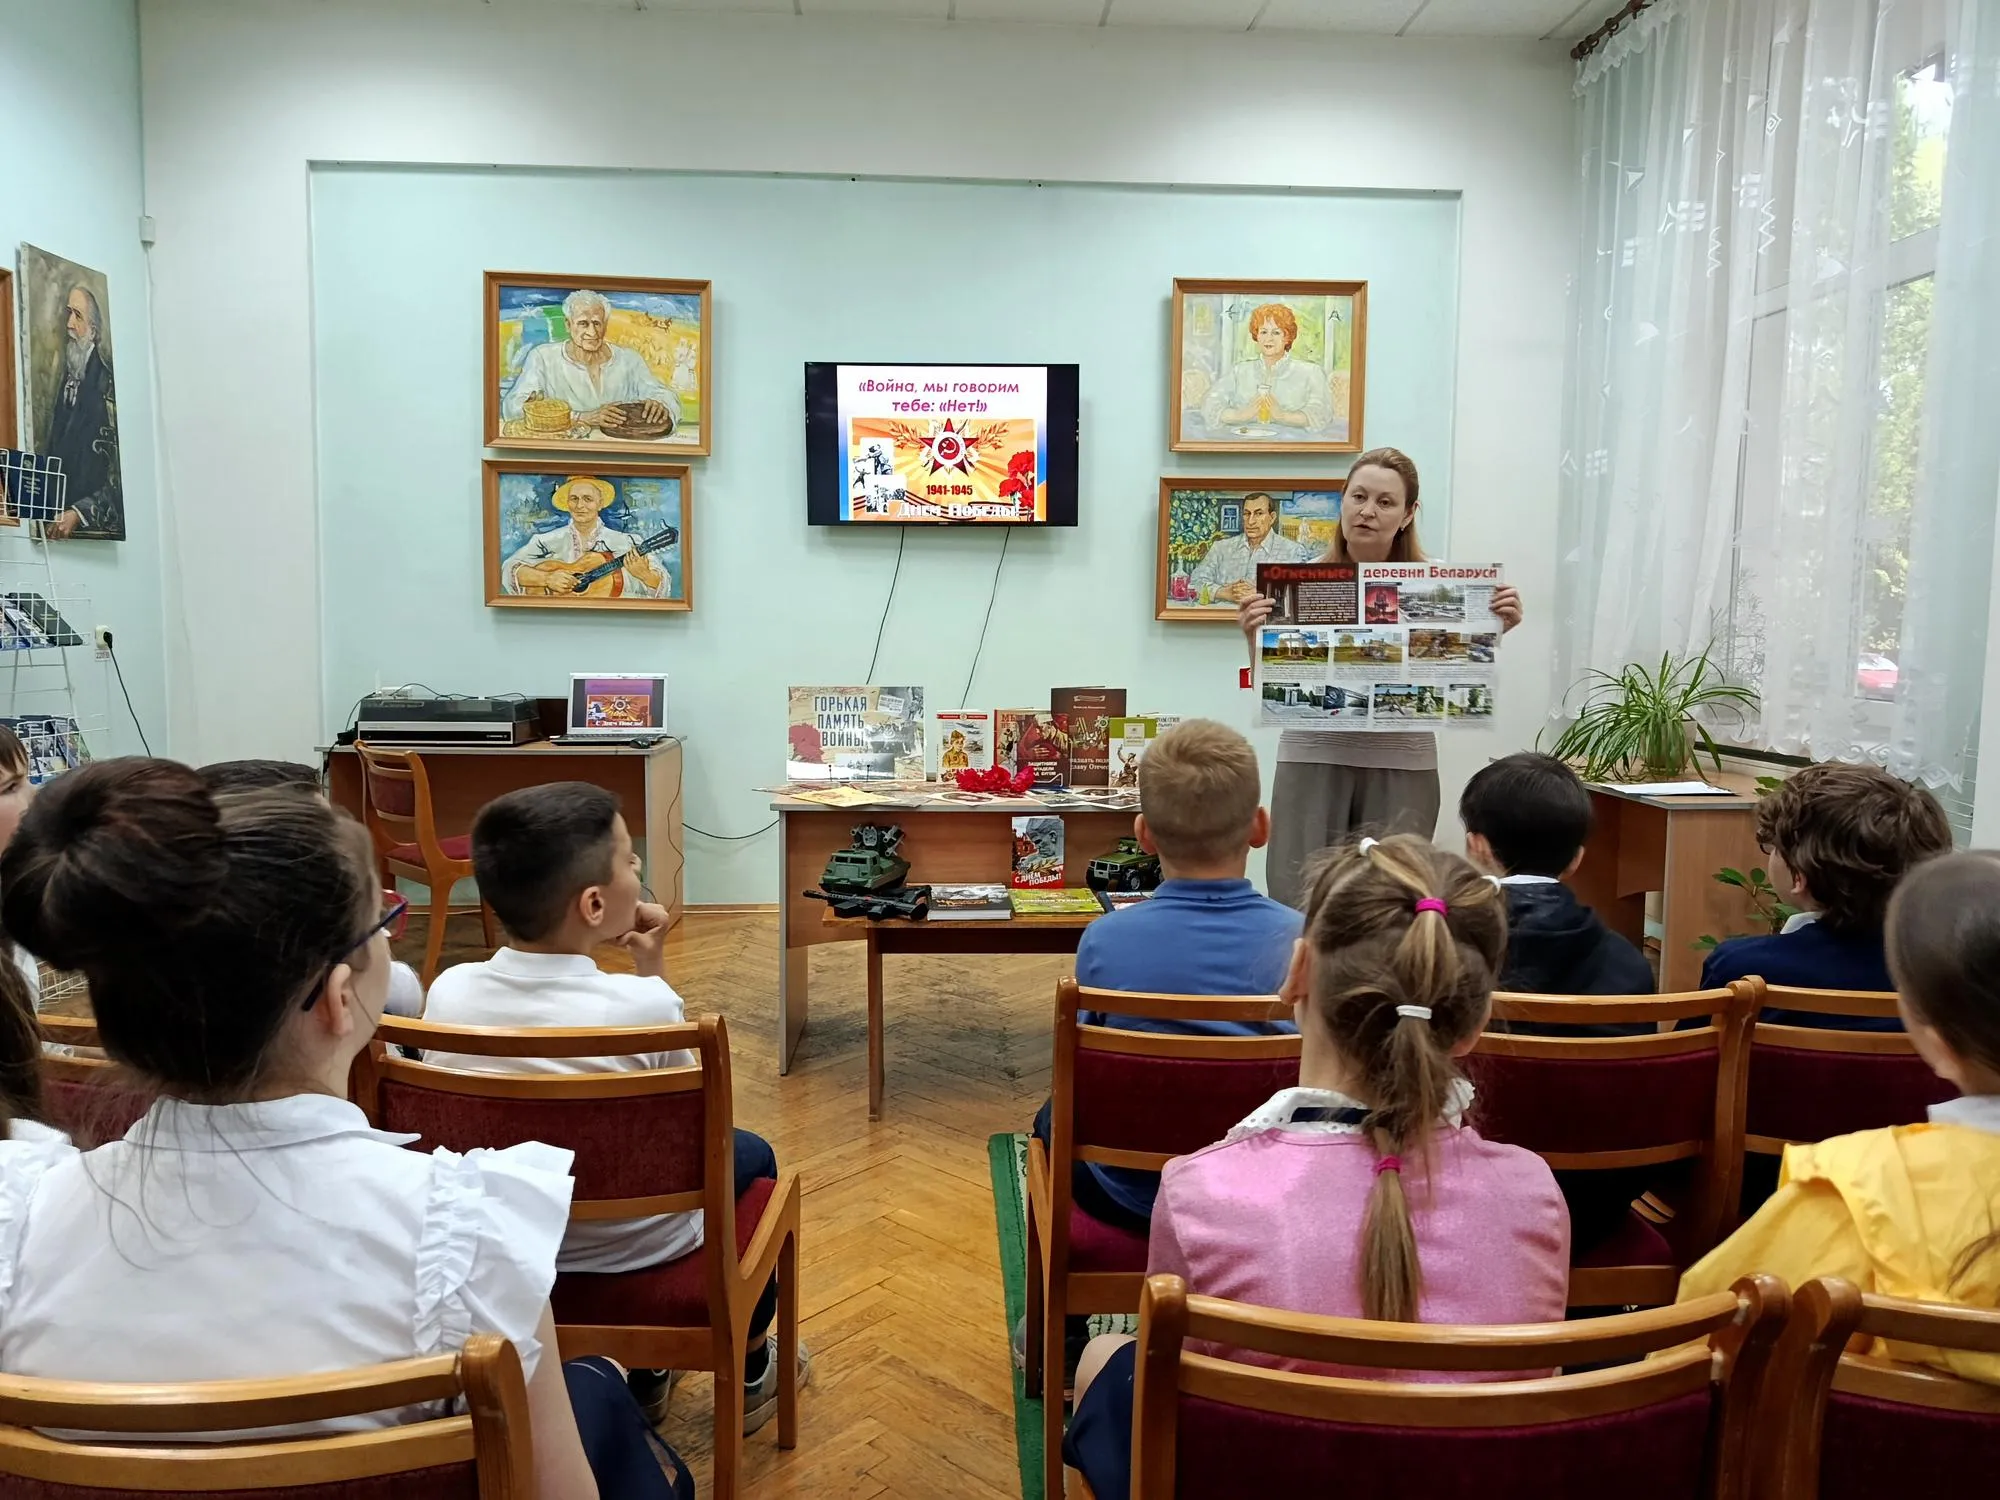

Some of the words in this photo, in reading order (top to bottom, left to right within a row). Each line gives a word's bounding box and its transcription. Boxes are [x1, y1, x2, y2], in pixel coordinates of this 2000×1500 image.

[858, 379, 918, 393] «Война,
[923, 383, 948, 393] мы
[953, 382, 1019, 394] говорим
[892, 399, 935, 412] тебе:
[939, 399, 988, 413] «Нет!»
[926, 484, 973, 496] 1941-1945
[1363, 568, 1425, 579] деревни
[1430, 566, 1497, 579] Беларуси
[814, 696, 867, 712] ГОРЬКАЯ
[817, 714, 864, 729] ПАМЯТЬ
[821, 730, 864, 747] ВОЙНЫ
